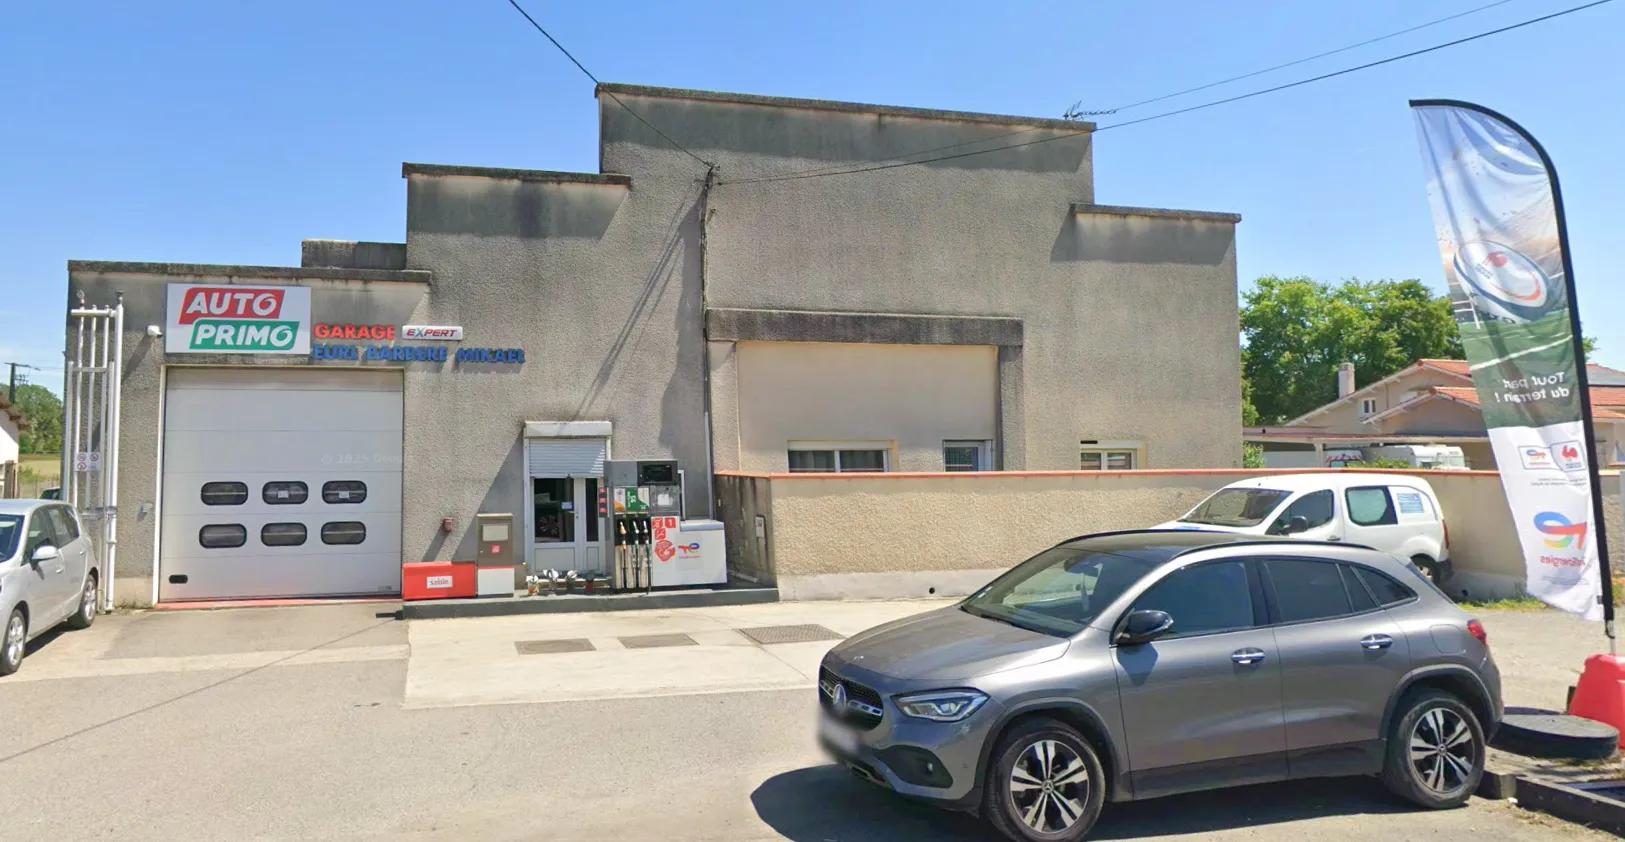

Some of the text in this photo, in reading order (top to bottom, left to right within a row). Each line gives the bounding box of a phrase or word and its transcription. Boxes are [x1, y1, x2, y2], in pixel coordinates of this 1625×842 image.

[185, 292, 277, 316] AUTO
[195, 324, 293, 347] PRIMO
[314, 322, 396, 340] GARAGE
[406, 328, 458, 338] EXPERT
